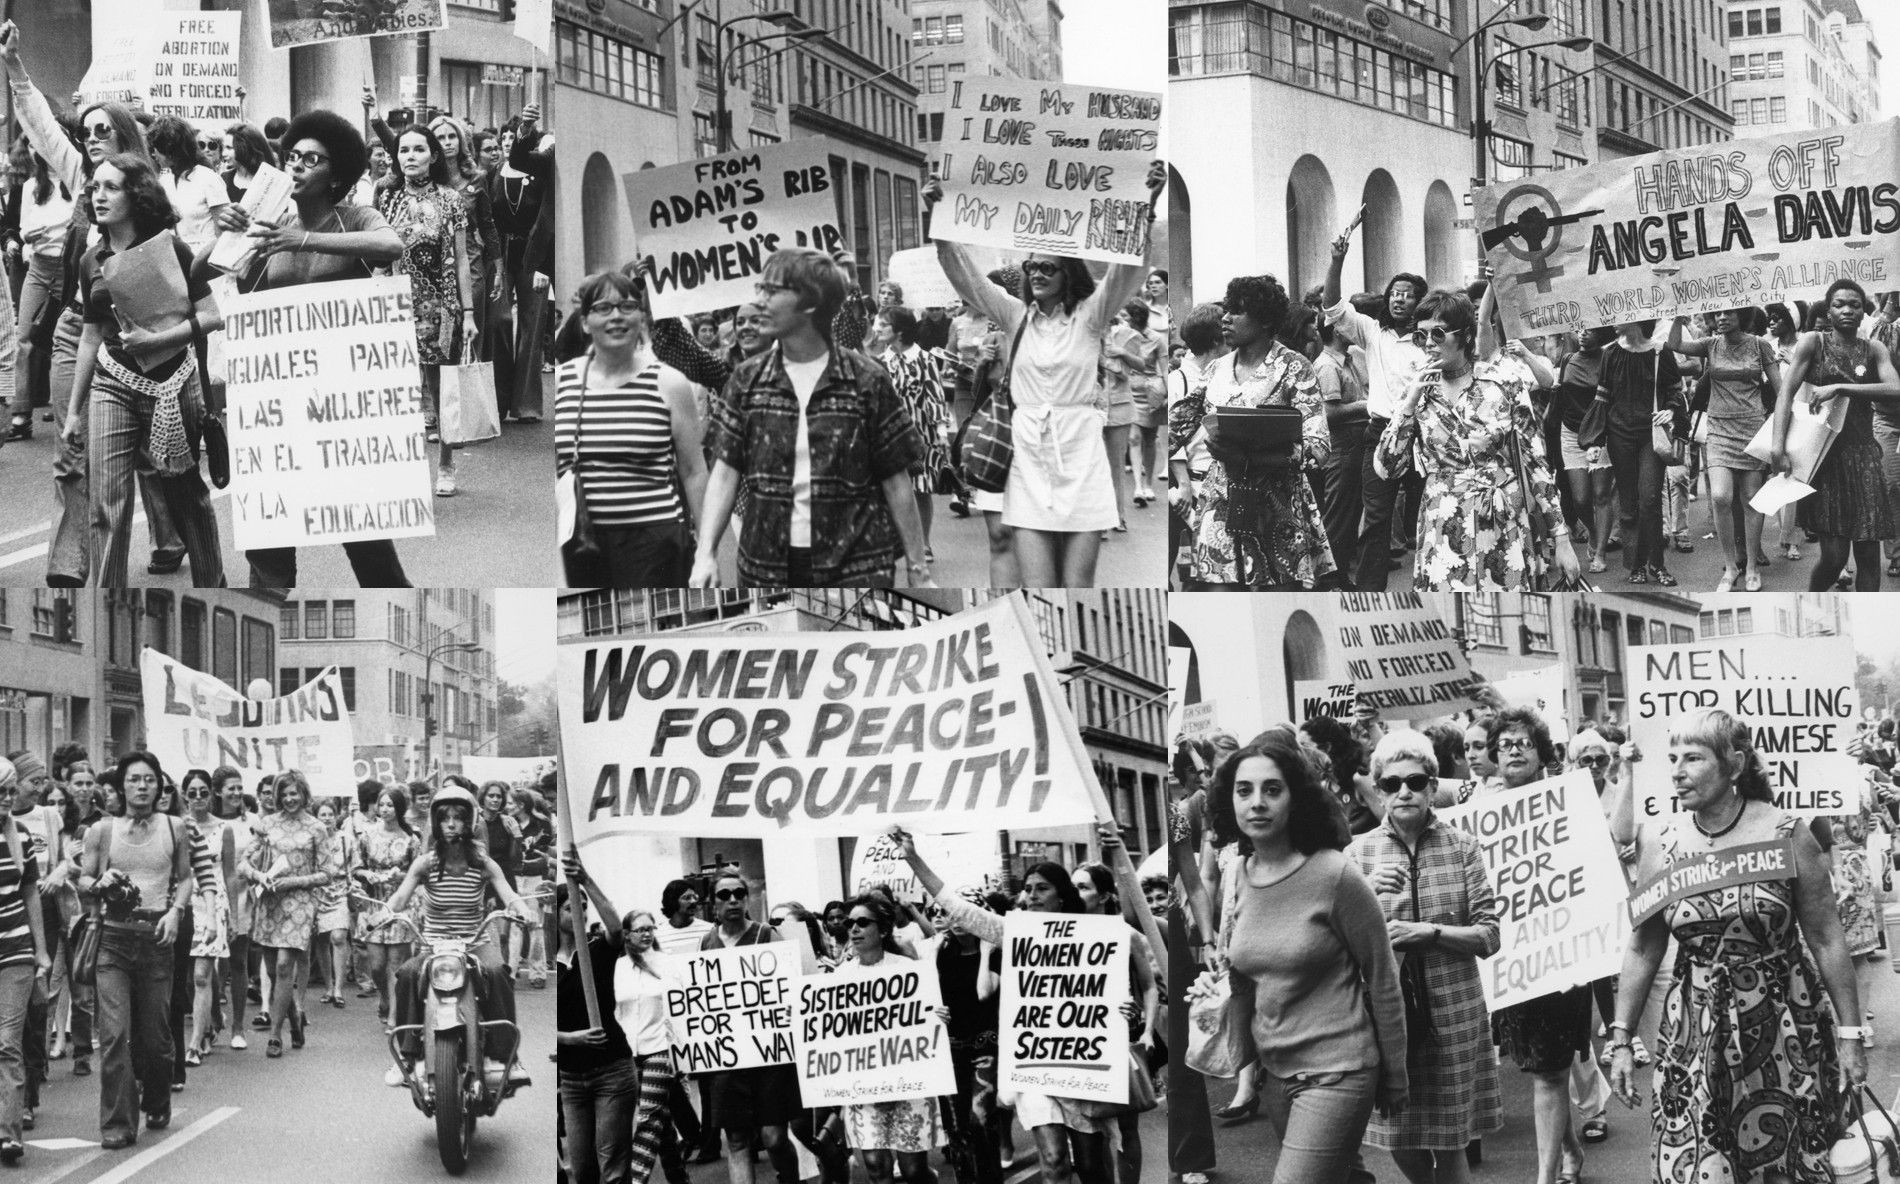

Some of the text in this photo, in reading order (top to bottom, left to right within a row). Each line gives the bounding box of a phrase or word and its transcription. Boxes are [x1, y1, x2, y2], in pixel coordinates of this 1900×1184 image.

[179, 20, 215, 34] FREE
[162, 41, 229, 55] ABORTION
[155, 63, 238, 77] ON DEMAND
[154, 83, 232, 98] NO FORCED
[951, 81, 963, 109] I
[980, 93, 1022, 112] LOVE
[1087, 92, 1161, 121] HUSBAND
[152, 105, 240, 119] STERILIZATION
[960, 118, 973, 140] I
[983, 118, 1036, 145] LOVE
[695, 154, 761, 183] FROM
[942, 153, 1114, 192] I ALSO LOVE
[1634, 135, 1845, 214] HANDS OFF
[650, 166, 829, 229] ADAM'S RIB
[718, 211, 757, 233] TO
[955, 193, 998, 231] MY
[1013, 202, 1083, 237] DAILY
[1588, 183, 1900, 275] ANGELA DAVIS
[1520, 258, 1887, 330] THIRD WORLD WOMEN'S ALLIANCE
[1700, 302, 1723, 311] New
[1729, 295, 1751, 308] York
[1760, 291, 1785, 303] City
[226, 294, 412, 340] OPORTUNIDADES
[228, 340, 417, 384] IGUALES PARA
[239, 386, 422, 430] LAS MUJERES
[235, 432, 428, 475] EN EL TRABAJO
[236, 492, 249, 521] Y
[260, 492, 288, 519] LA
[1339, 618, 1450, 648] ON DEMAND
[583, 622, 1000, 724] WOMEN STRIKE
[1347, 650, 1456, 680] NO FORCED
[1328, 683, 1355, 698] THE
[1356, 679, 1472, 709] STERILIZATIO
[1735, 686, 1852, 718] KILLING
[649, 706, 792, 758] FOR
[588, 763, 700, 822] AND
[1480, 816, 1570, 869] TRIKE
[873, 863, 895, 875] AND
[1497, 852, 1556, 895] FOR
[1630, 877, 1669, 919] WOMEN
[1670, 860, 1721, 893] STRIKE
[1737, 848, 1786, 874] PEACE
[1043, 920, 1077, 938] THE
[1512, 906, 1572, 950] AND
[1011, 937, 1118, 967] WOMEN OF
[1492, 901, 1626, 999] EQUALITY!
[688, 950, 778, 986] I'M NO
[1018, 970, 1108, 998] VIETNAM
[800, 972, 919, 1016] SISTERHOOD
[687, 1008, 790, 1037] FOR THE
[804, 1000, 934, 1043] IS POWERFUL-
[1012, 1001, 1109, 1029] ARE OUR
[806, 1024, 941, 1079] END THE WAR!
[1014, 1031, 1107, 1061] SISTERS
[824, 1087, 851, 1098] WOMEN
[1010, 1072, 1040, 1085] WOMEN
